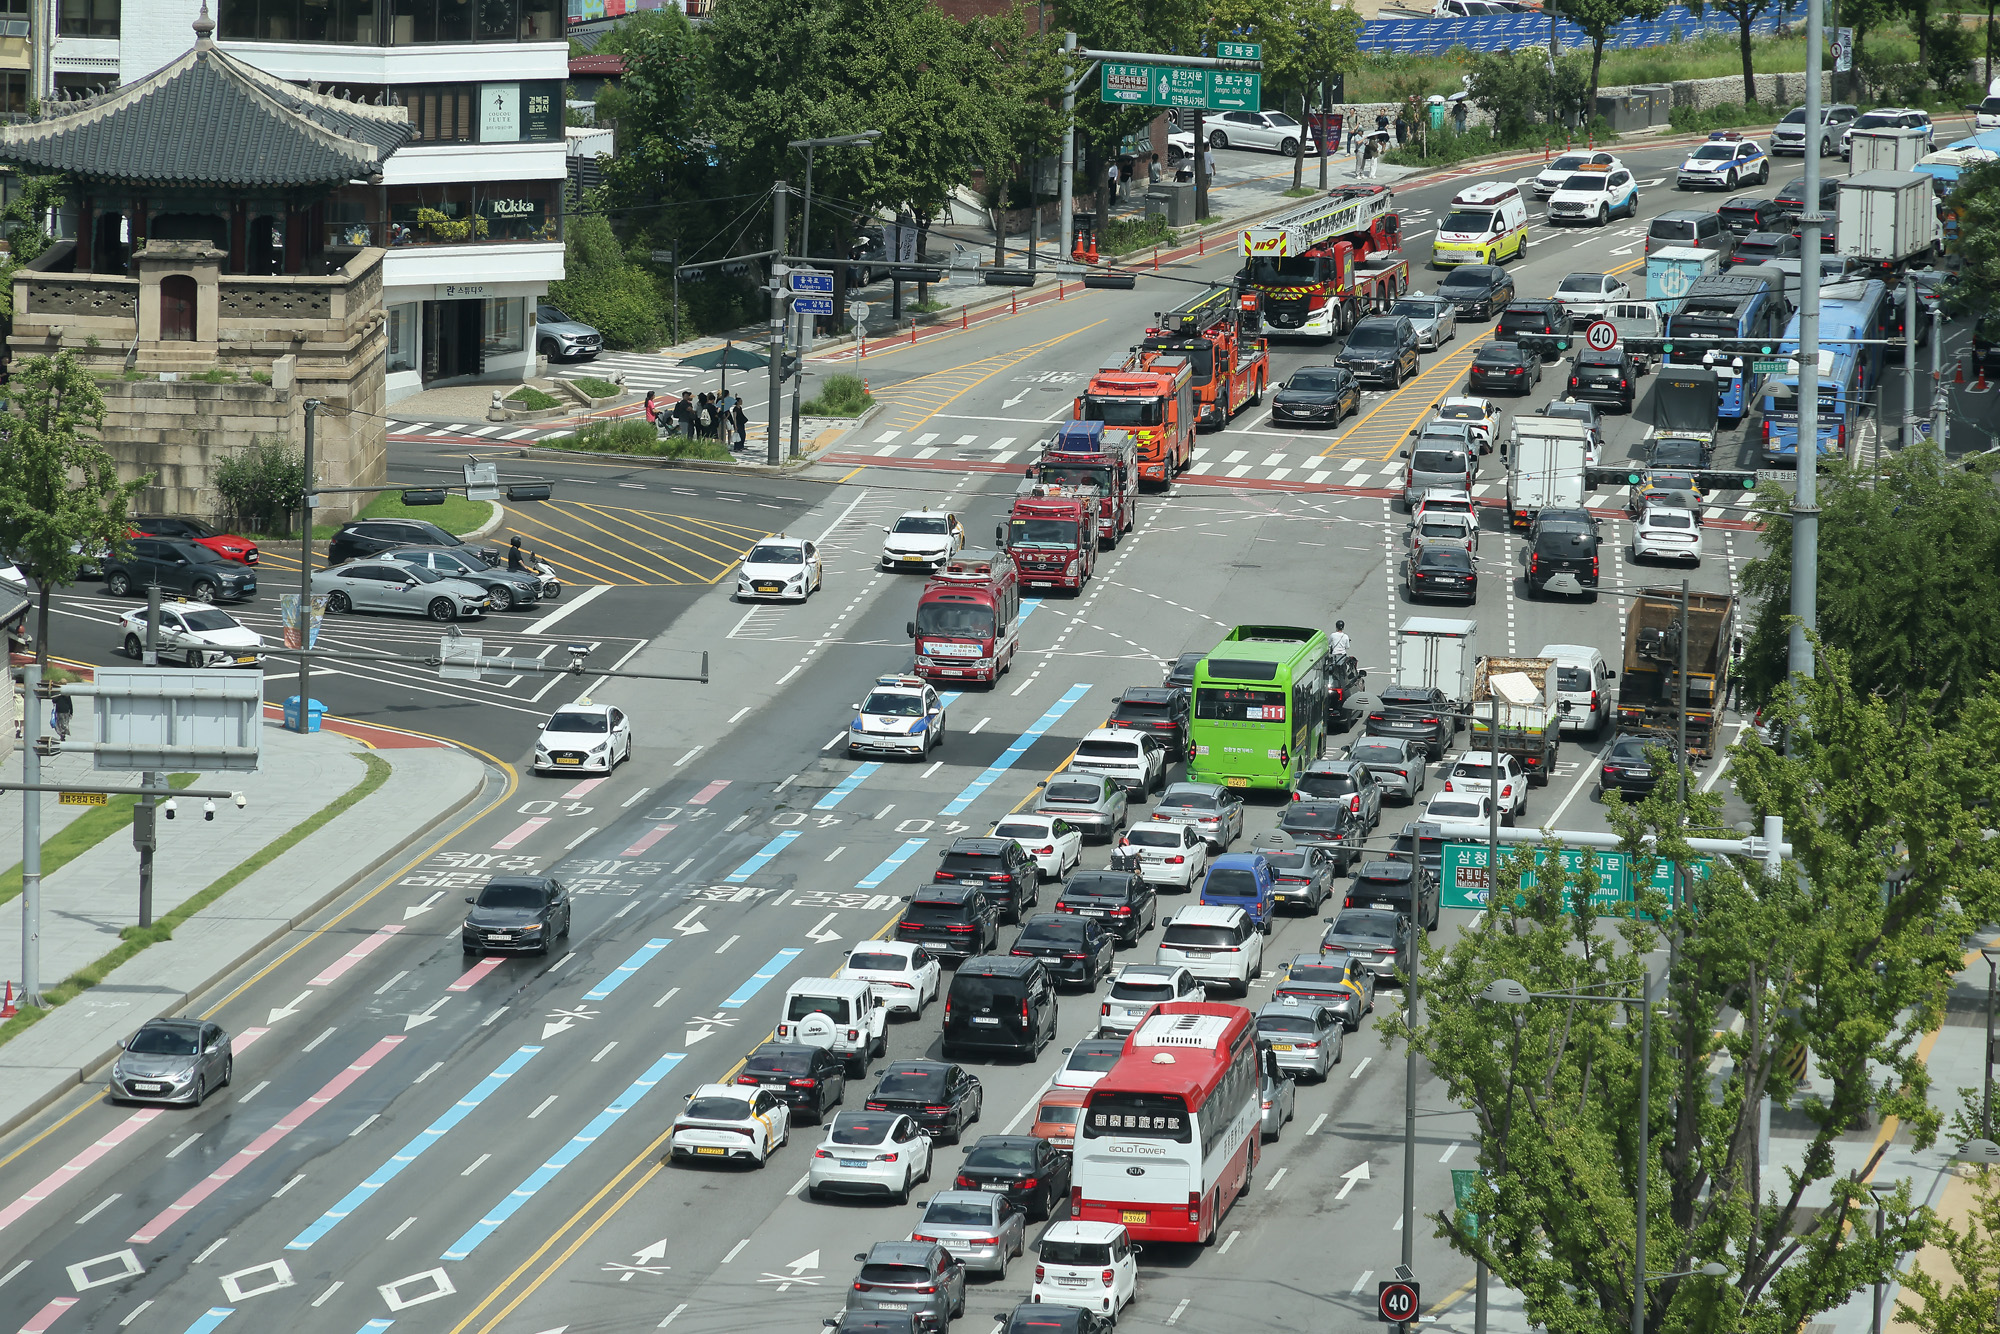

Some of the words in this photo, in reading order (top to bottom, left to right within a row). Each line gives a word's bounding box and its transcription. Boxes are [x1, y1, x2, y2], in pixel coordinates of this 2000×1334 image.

[1224, 45, 1254, 57] 경복궁
[1108, 66, 1148, 76] 삼청터널
[1172, 70, 1202, 81] 흥인지문
[1108, 75, 1147, 85] 국립민속박물관
[1214, 74, 1253, 87] 종로구청
[1214, 86, 1230, 95] Jongno
[529, 96, 549, 105] 경복궁
[1172, 95, 1205, 106] 안국동사거리
[1254, 238, 1279, 250] 119
[446, 286, 455, 296] 란
[458, 286, 483, 294] 스튜디오
[1592, 327, 1611, 344] 40
[1270, 708, 1283, 718] 11
[90, 796, 107, 804] 단속중
[517, 800, 594, 816] 40
[770, 812, 842, 828] 40
[894, 819, 970, 834] 40
[1457, 880, 1480, 888] National
[791, 890, 901, 911] 세종로
[1109, 1145, 1166, 1155] GOLDTOWER
[1128, 1215, 1145, 1223] 3966
[1389, 1294, 1409, 1312] 40
